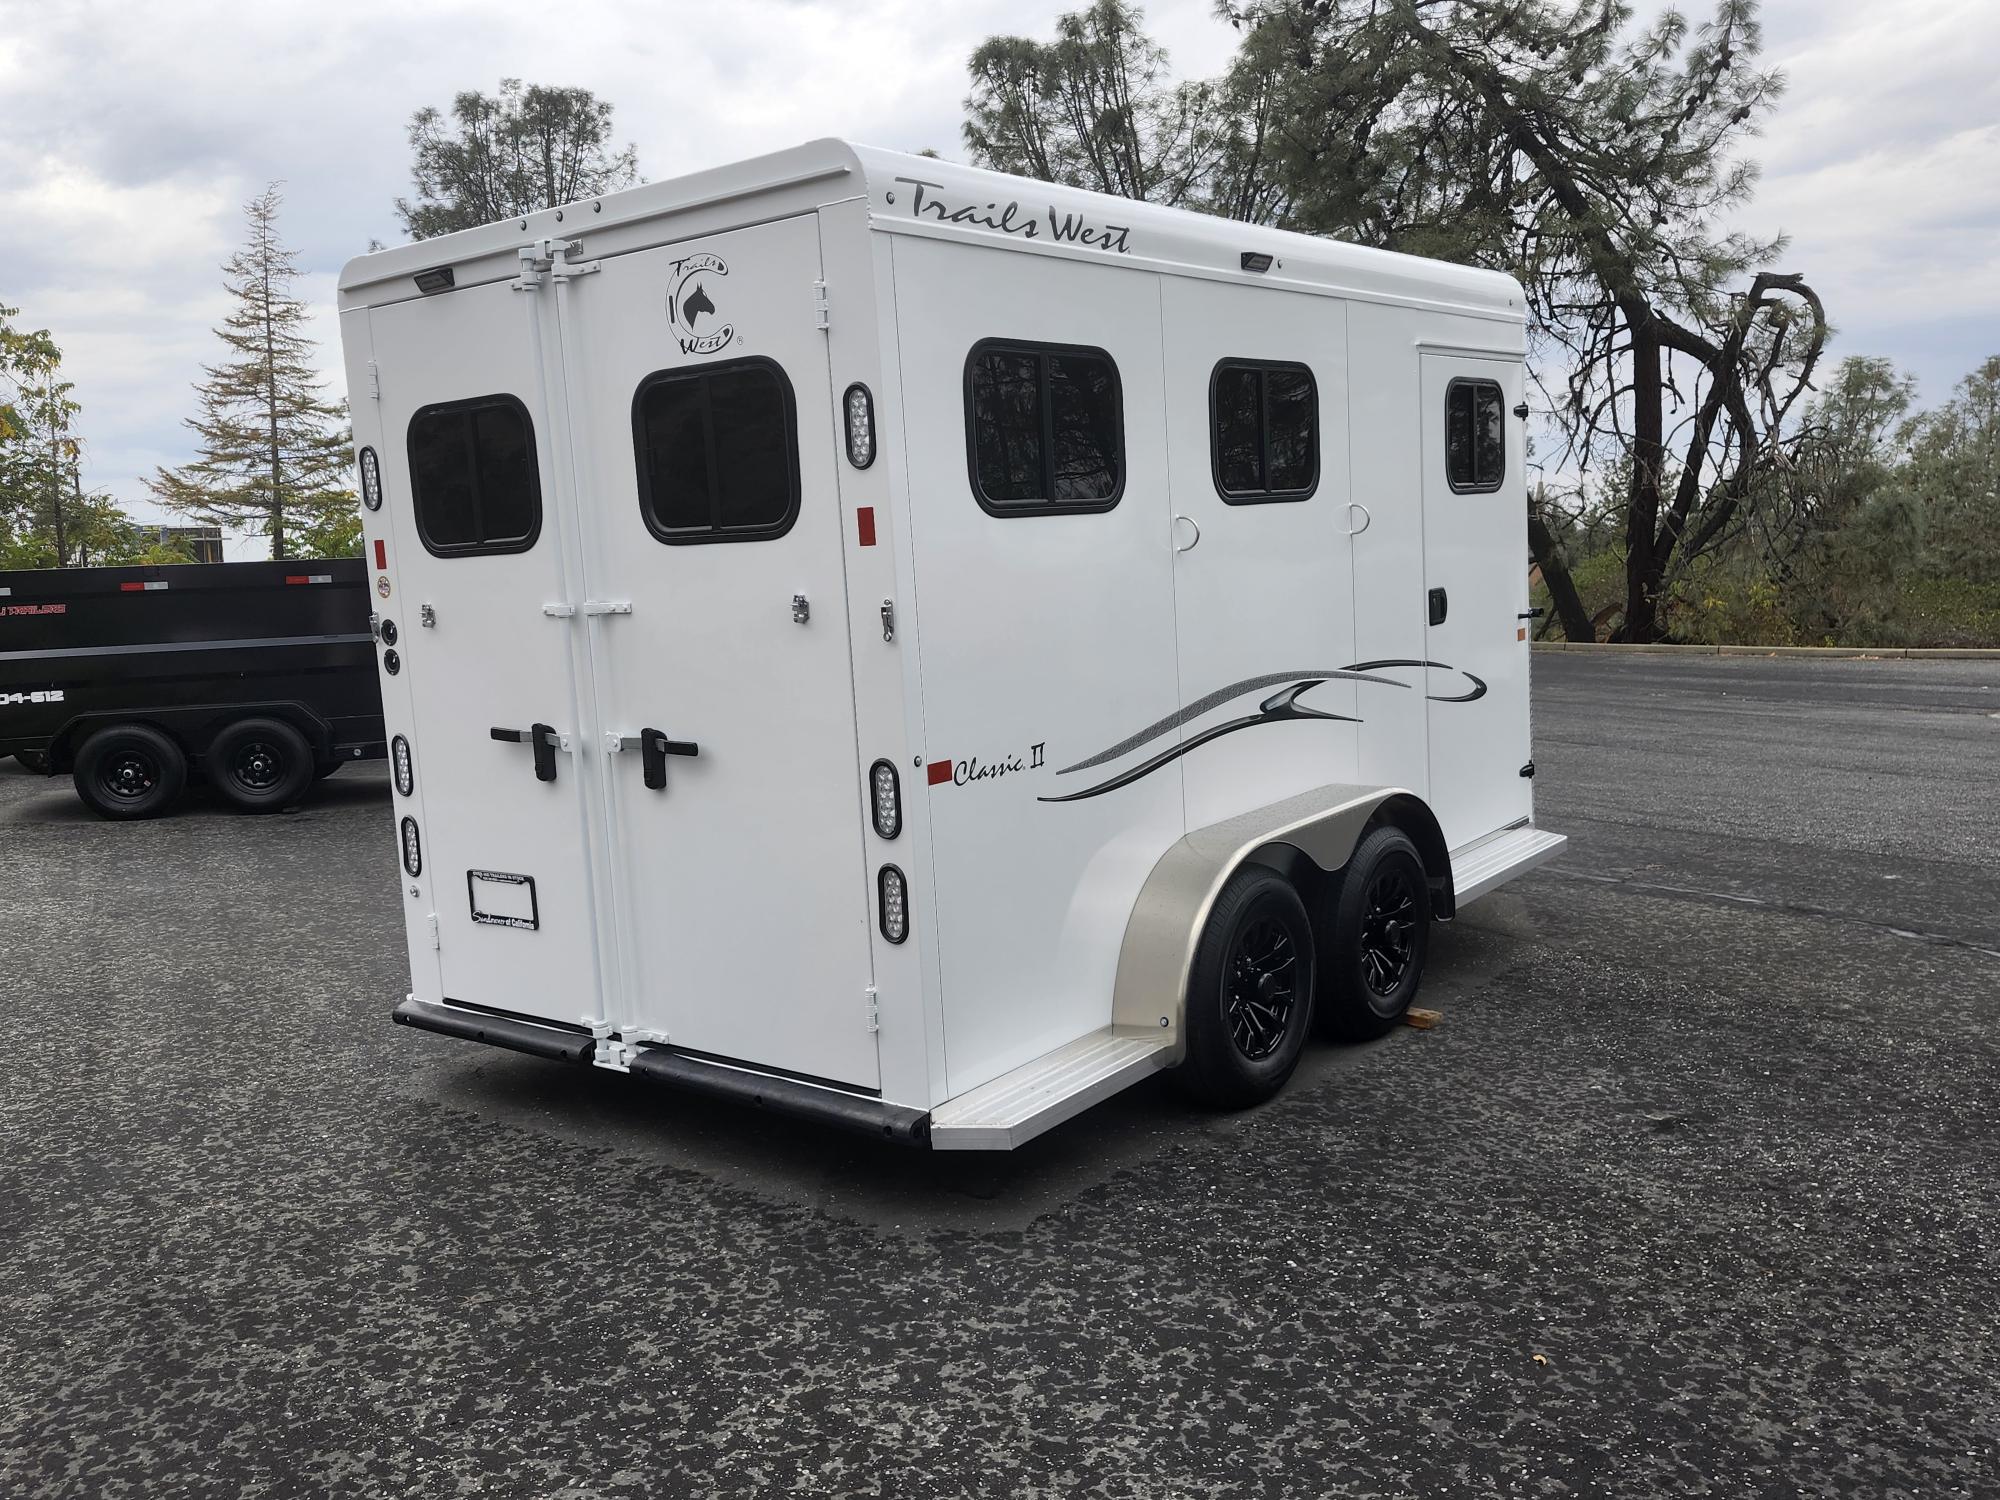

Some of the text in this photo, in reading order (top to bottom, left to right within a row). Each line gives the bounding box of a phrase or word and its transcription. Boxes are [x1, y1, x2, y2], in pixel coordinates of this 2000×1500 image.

[894, 176, 1131, 254] Trails West
[669, 257, 716, 277] Trails
[680, 336, 722, 355] West
[7, 604, 66, 616] TRAILERS
[953, 741, 1046, 787] Classic II
